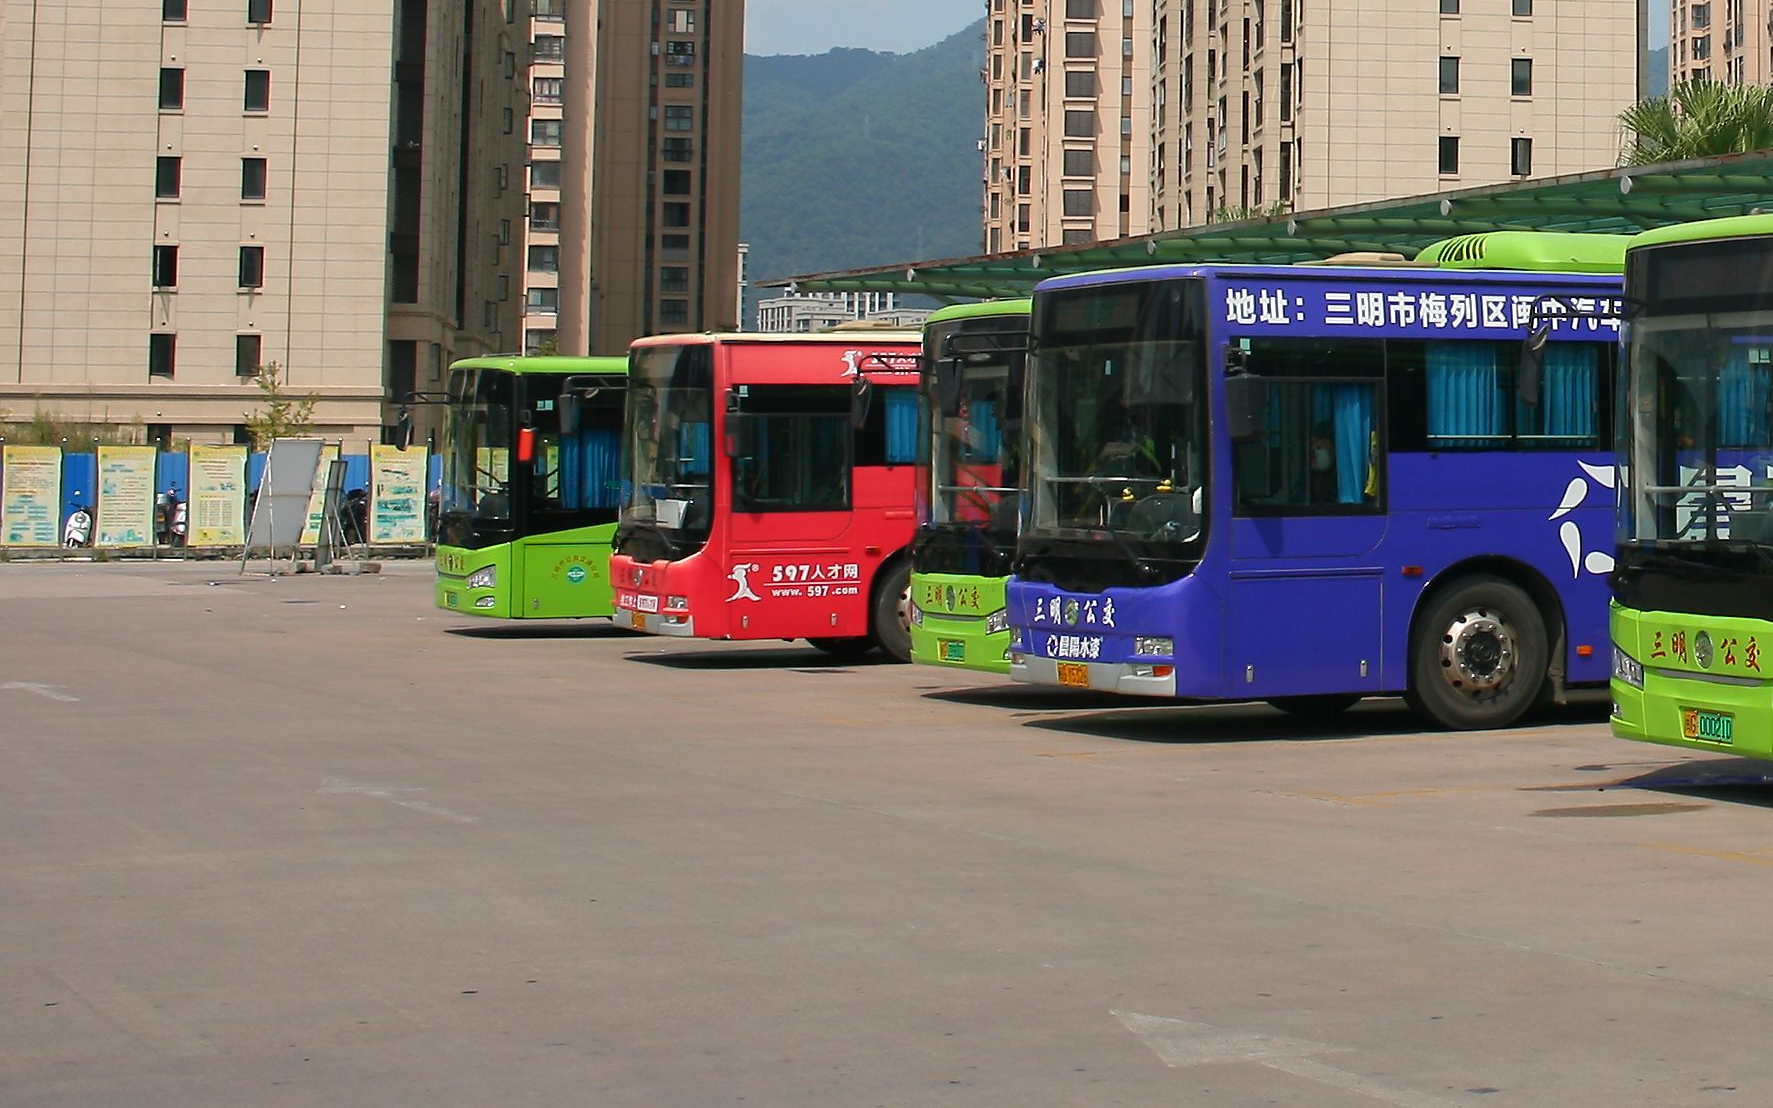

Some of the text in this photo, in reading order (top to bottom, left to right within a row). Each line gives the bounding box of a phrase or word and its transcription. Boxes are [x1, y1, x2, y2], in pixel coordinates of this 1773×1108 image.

[772, 563, 858, 582] 597人才网
[1034, 596, 1115, 628] 三明 公交
[1650, 630, 1761, 673] 三明 公交
